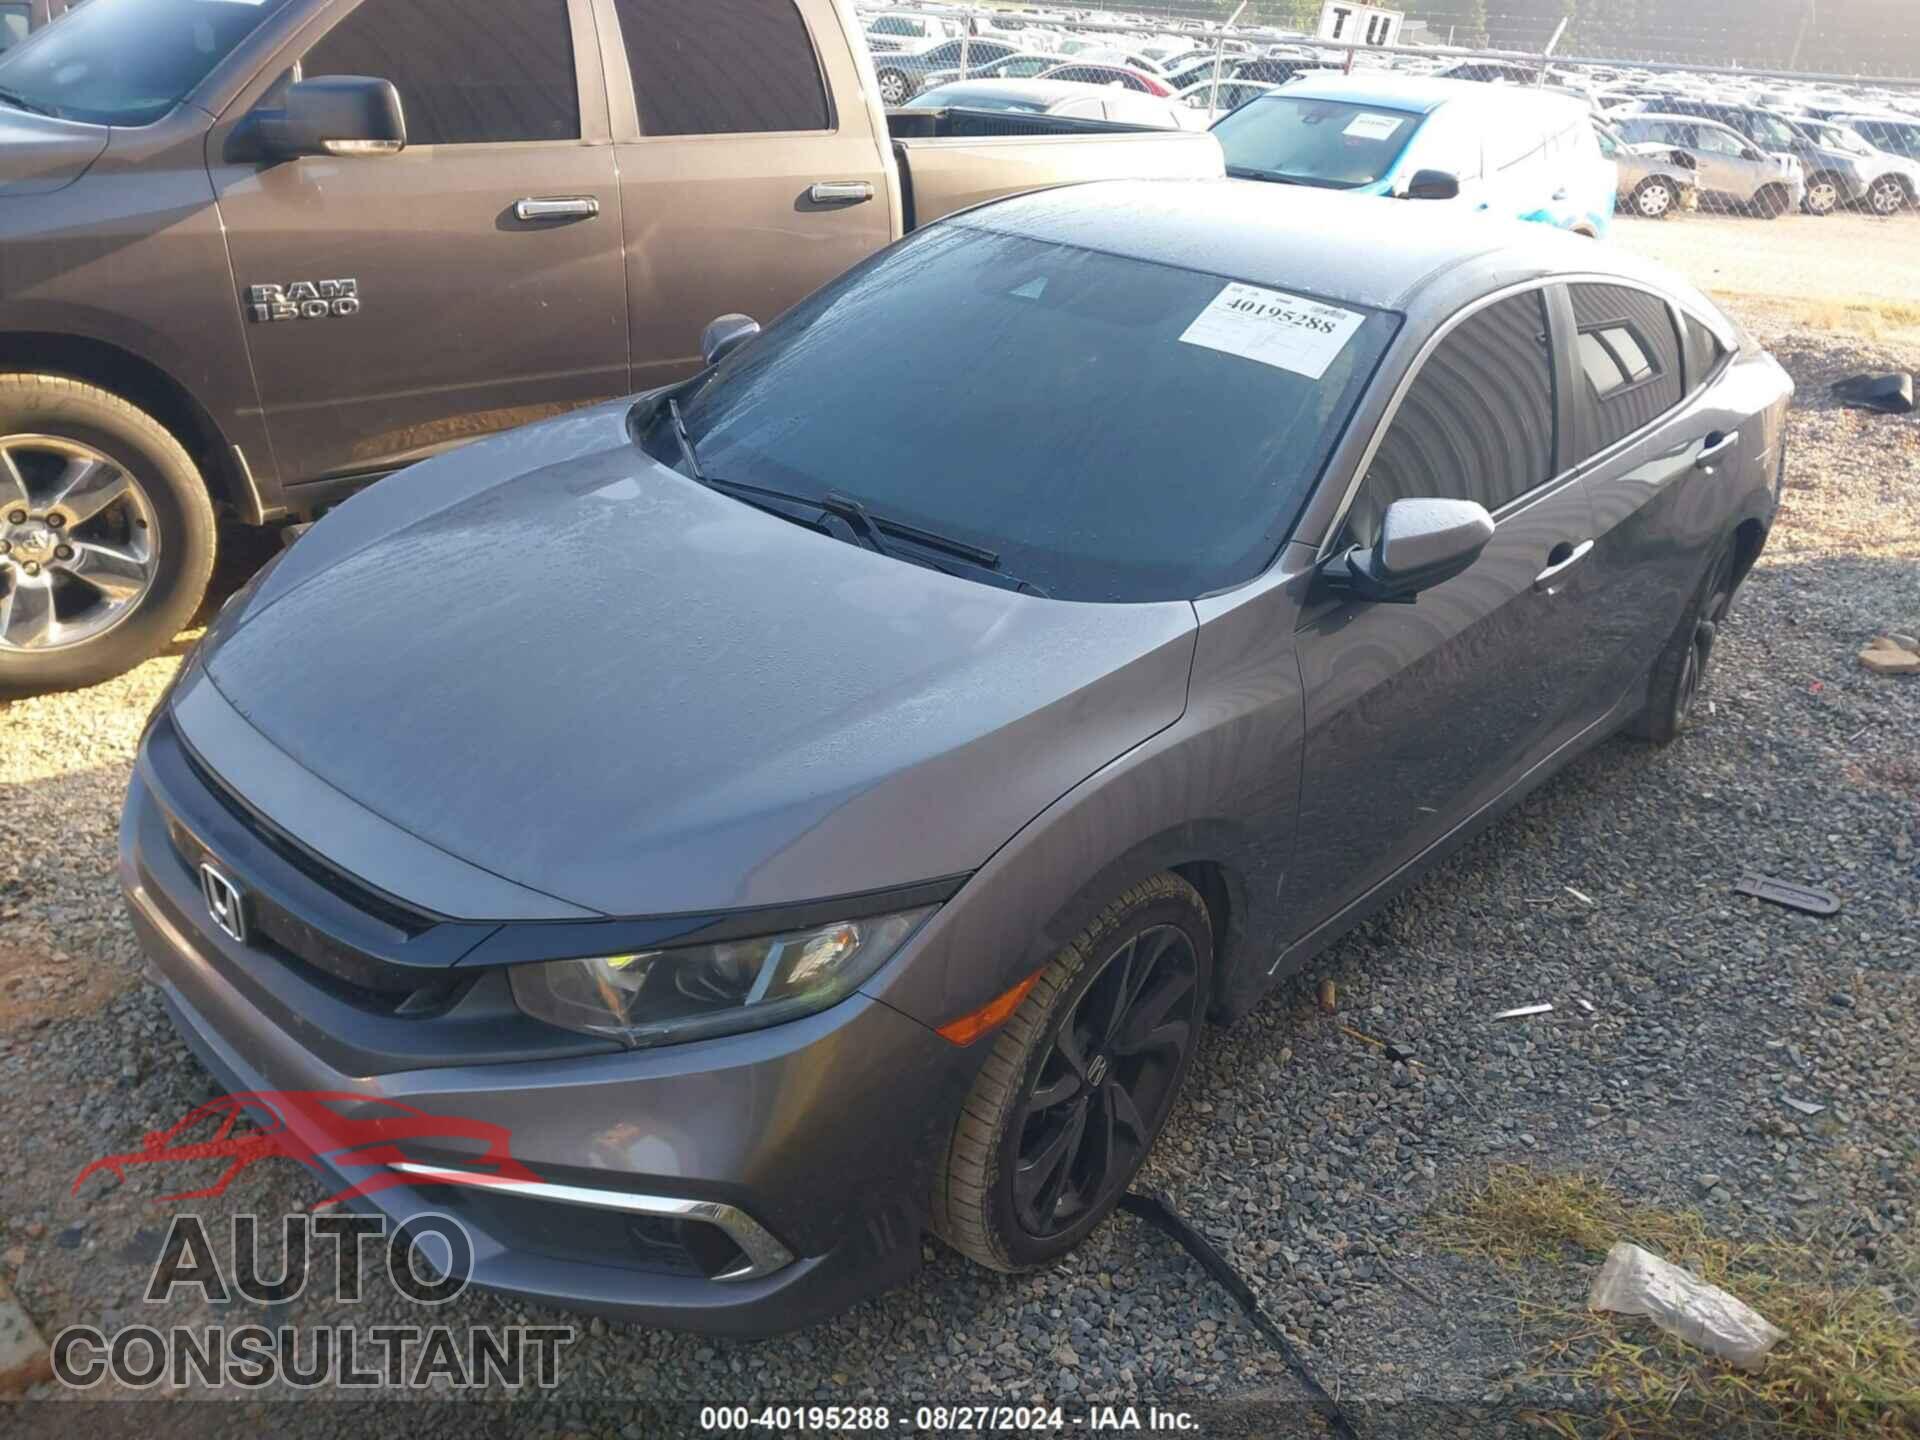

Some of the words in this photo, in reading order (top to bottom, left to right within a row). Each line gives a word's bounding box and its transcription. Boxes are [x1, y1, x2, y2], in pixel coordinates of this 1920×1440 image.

[1332, 7, 1352, 39] T
[1366, 15, 1391, 46] U
[249, 278, 357, 303] RAM
[252, 297, 360, 321] 1500
[1226, 298, 1337, 334] 40195288
